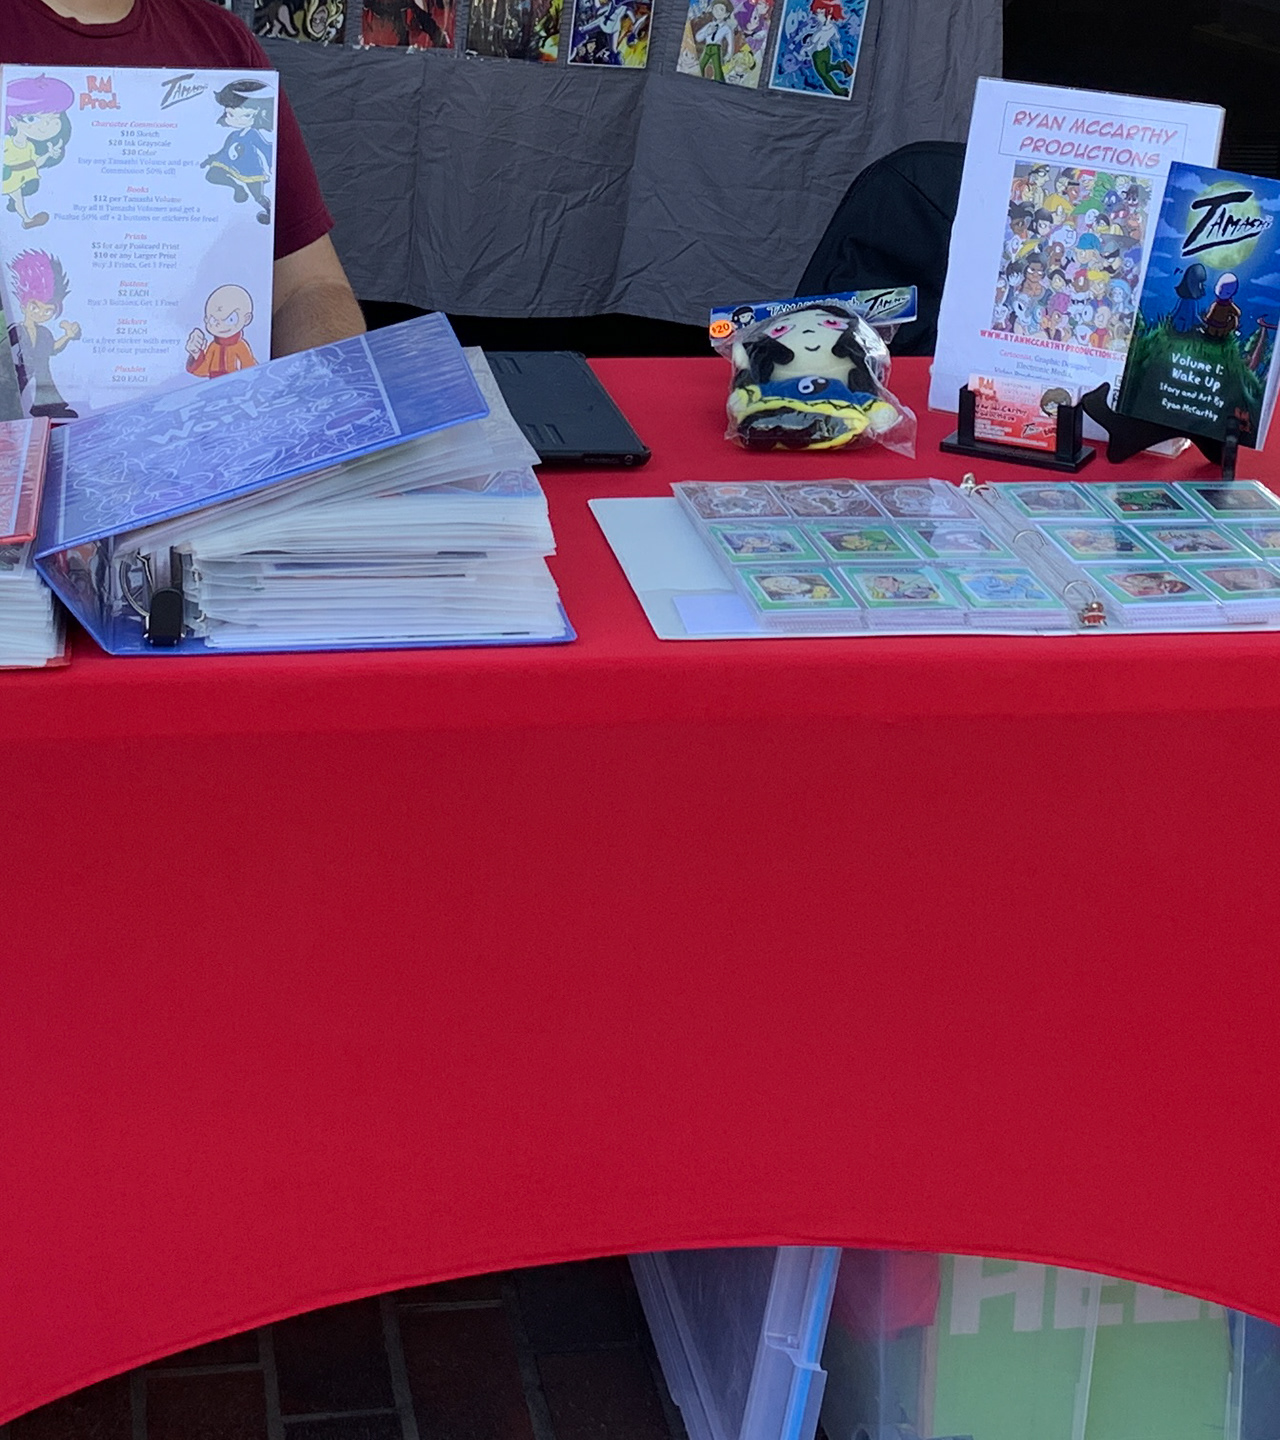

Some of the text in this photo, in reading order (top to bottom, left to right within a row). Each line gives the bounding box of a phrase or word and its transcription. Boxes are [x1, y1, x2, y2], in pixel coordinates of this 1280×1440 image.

[86, 75, 112, 93] RM
[1012, 110, 1178, 146] RYAN MCCARTHY
[1019, 136, 1161, 169] PRODUCTIONS
[1181, 191, 1274, 257] TAMASHI
[134, 252, 157, 260] Larger
[711, 323, 730, 333] $20
[1172, 353, 1212, 372] Volume
[1172, 368, 1220, 392] Wake Up
[1160, 382, 1224, 408] Story and Art By
[1162, 398, 1181, 409] Ryan
[1182, 403, 1218, 422] McCarthy
